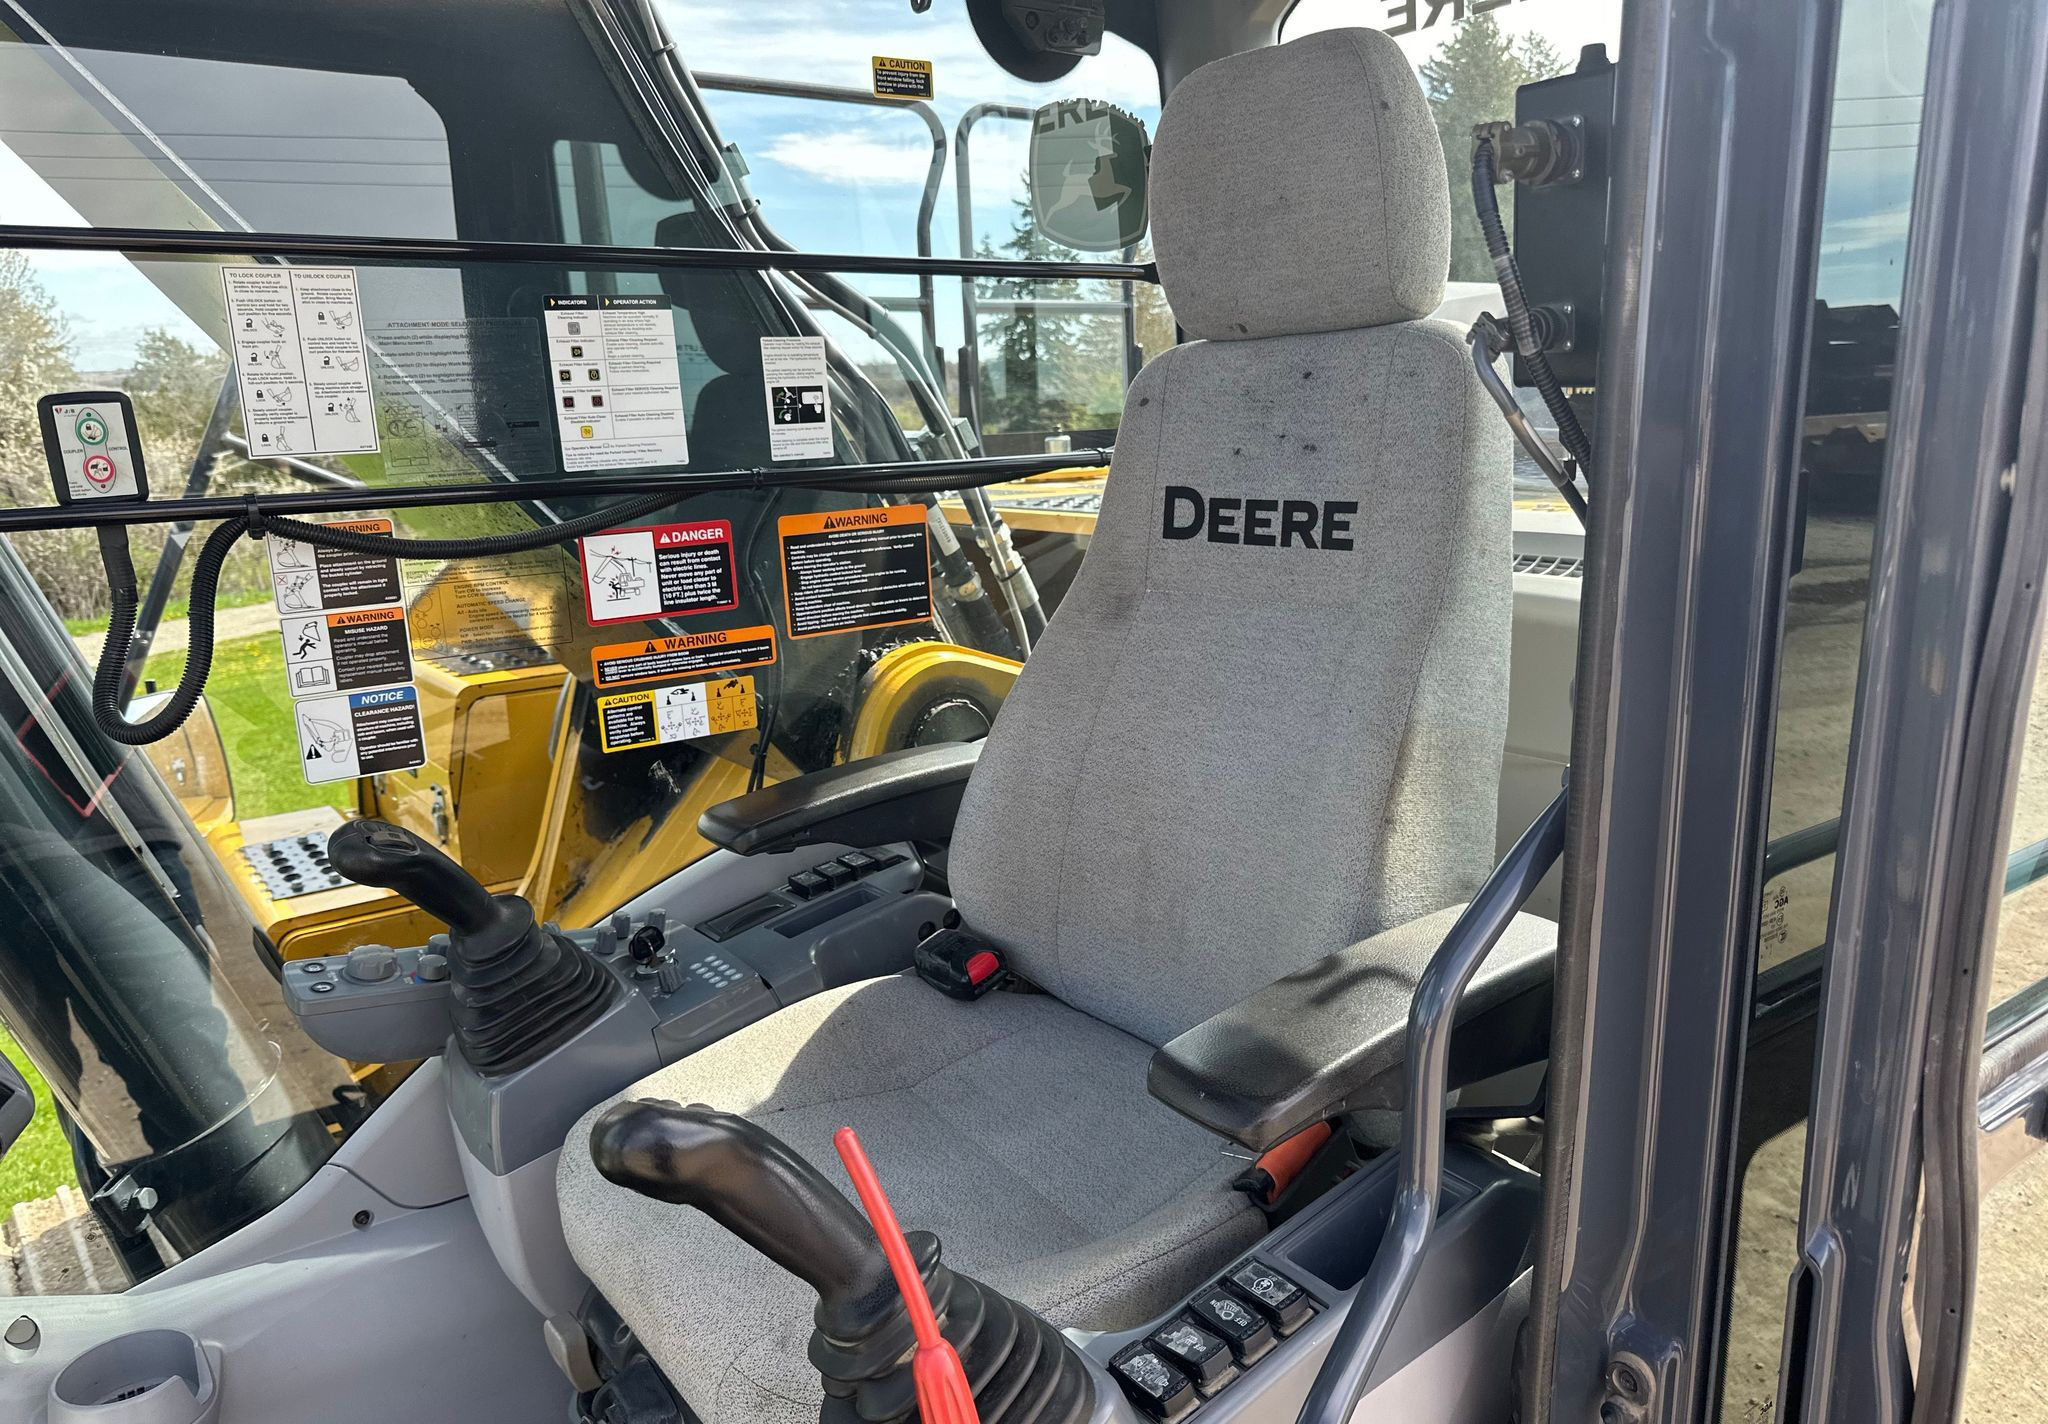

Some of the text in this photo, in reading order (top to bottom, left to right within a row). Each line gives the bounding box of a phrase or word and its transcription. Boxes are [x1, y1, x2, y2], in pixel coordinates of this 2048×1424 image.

[890, 60, 925, 70] CAUTION
[835, 513, 888, 527] WARNING
[1162, 486, 1358, 551] DEERE
[672, 528, 724, 542] DANGER
[346, 612, 394, 623] WARNING
[664, 632, 727, 650] WARNING
[361, 691, 404, 704] NOTICE
[612, 694, 650, 704] CAUTION
[354, 708, 390, 717] CLEARANCE
[1234, 1317, 1248, 1327] OFF
